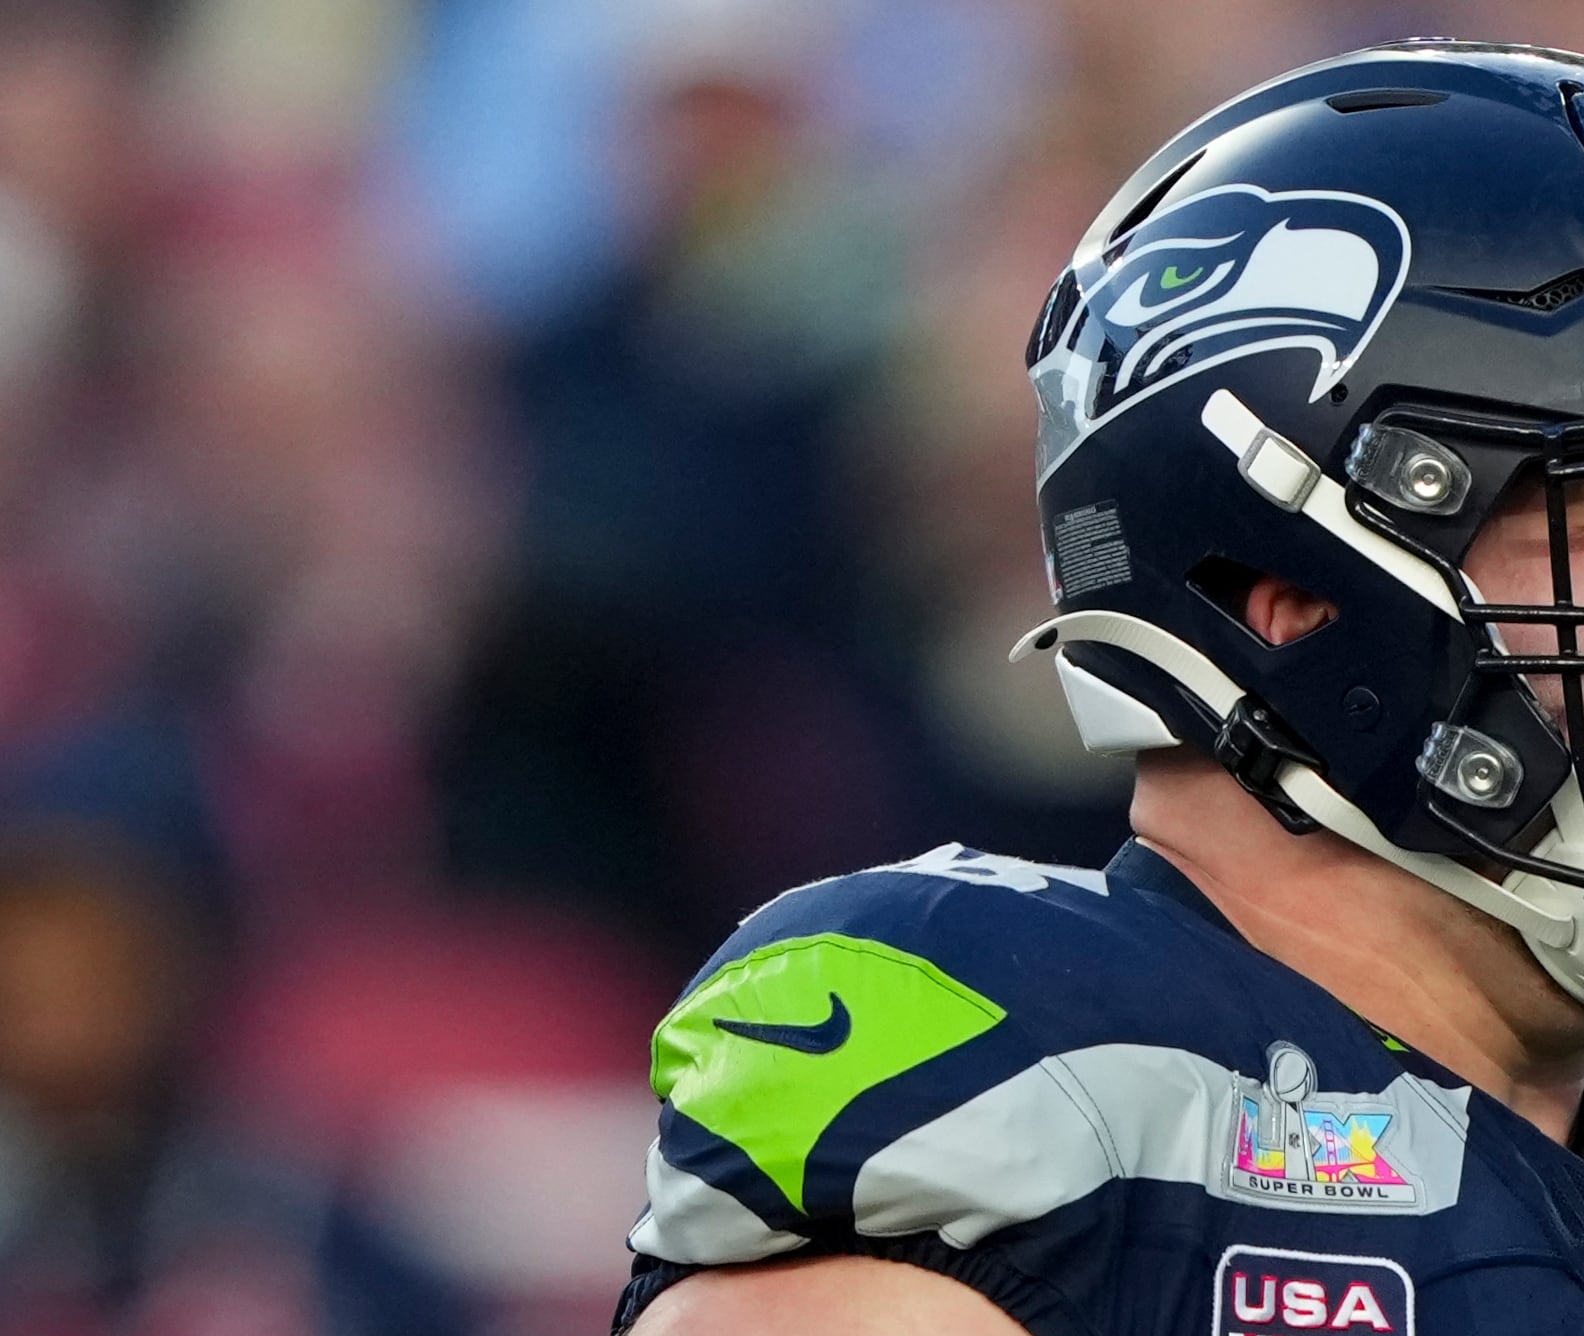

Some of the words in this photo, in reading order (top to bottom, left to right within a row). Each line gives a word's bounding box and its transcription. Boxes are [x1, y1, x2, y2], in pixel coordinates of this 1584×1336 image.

[1249, 1176, 1314, 1195] SUPER
[1324, 1183, 1389, 1199] BOWL
[1232, 1271, 1394, 1332] USA
